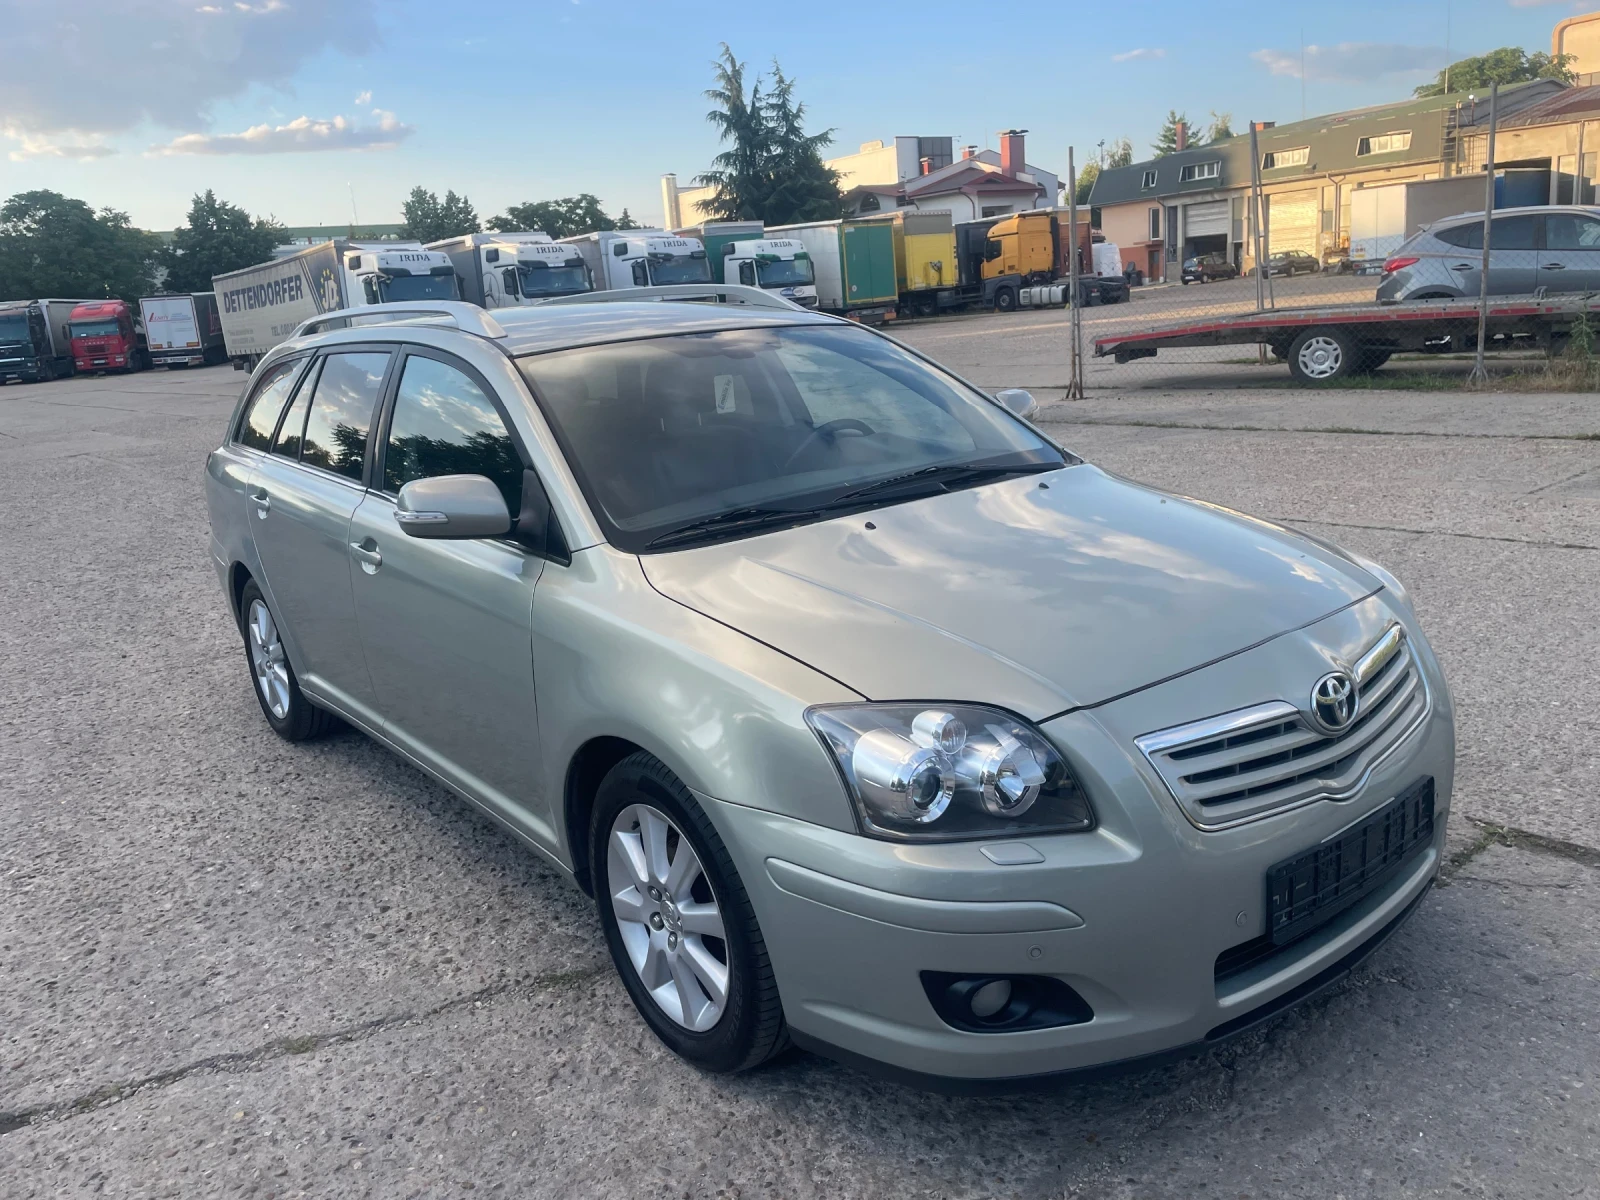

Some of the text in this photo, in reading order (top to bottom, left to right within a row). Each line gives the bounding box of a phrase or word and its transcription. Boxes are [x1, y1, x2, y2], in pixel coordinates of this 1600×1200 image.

[663, 240, 689, 248] IRIDA
[770, 241, 793, 249] IRIDA
[536, 246, 565, 254] IRIDA
[399, 254, 431, 262] IRIDA
[223, 274, 304, 314] DETTENDORFER
